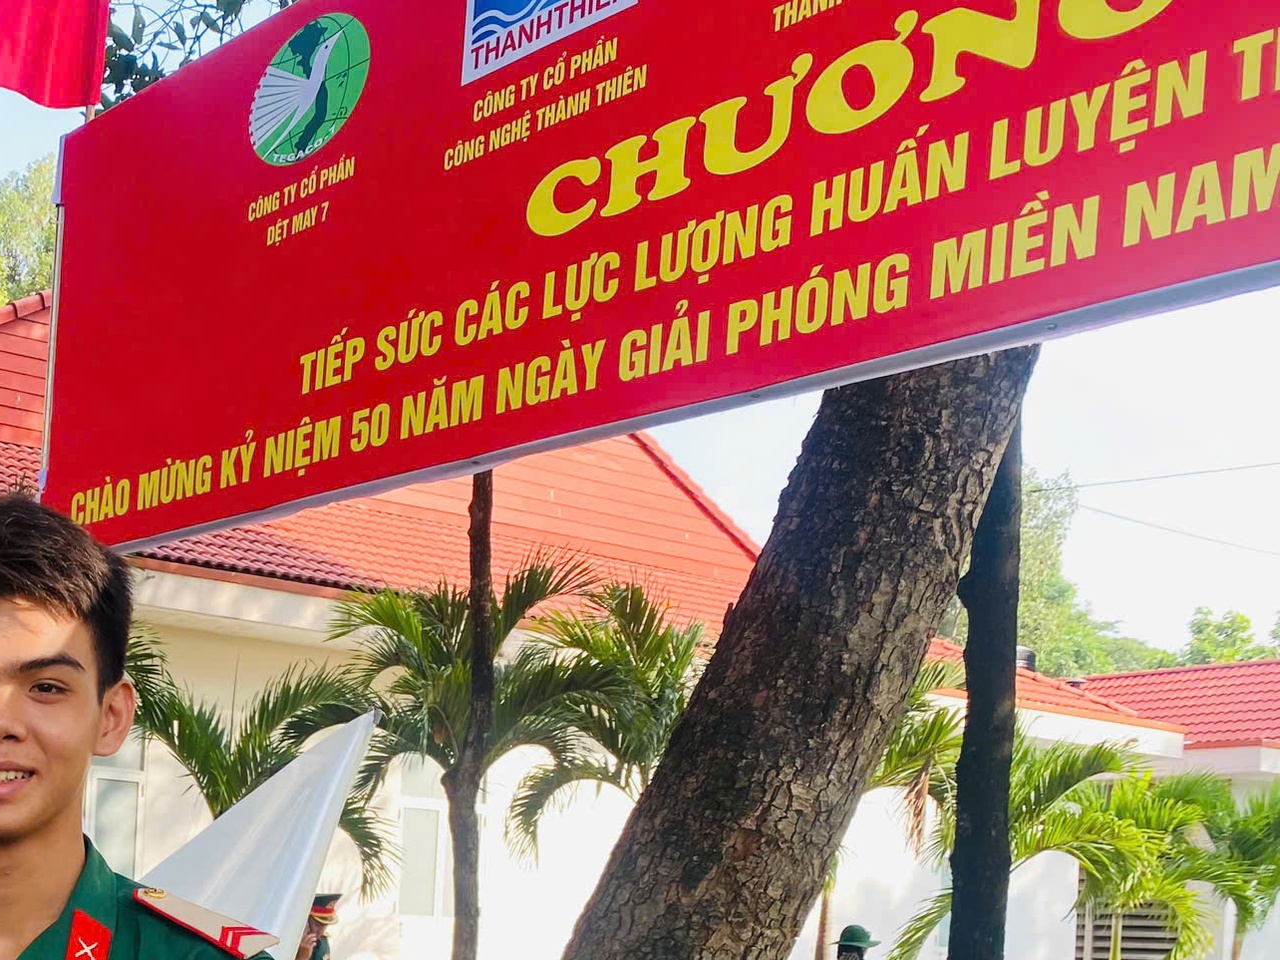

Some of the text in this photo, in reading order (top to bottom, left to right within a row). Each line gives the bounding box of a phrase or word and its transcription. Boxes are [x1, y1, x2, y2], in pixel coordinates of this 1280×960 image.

[471, 0, 618, 70] THANHTHI
[445, 65, 646, 170] CÔNG NGHỆ THÀNH THIÊN
[474, 36, 618, 121] CÔNG TY CỔ PHẦN
[248, 154, 355, 222] CÔNG TY CỔ PHẦN
[267, 201, 329, 246] DỆT MAY 7
[300, 27, 1280, 394] TIẾP SỨC CÁC LỰC LƯỢNG HUẤN LUYỆN T
[71, 143, 1280, 525] CHÀO MỪNG KỶ NIỆM 50 NĂM NGÀY GIẢI PHÓNG MIỀN NAM
